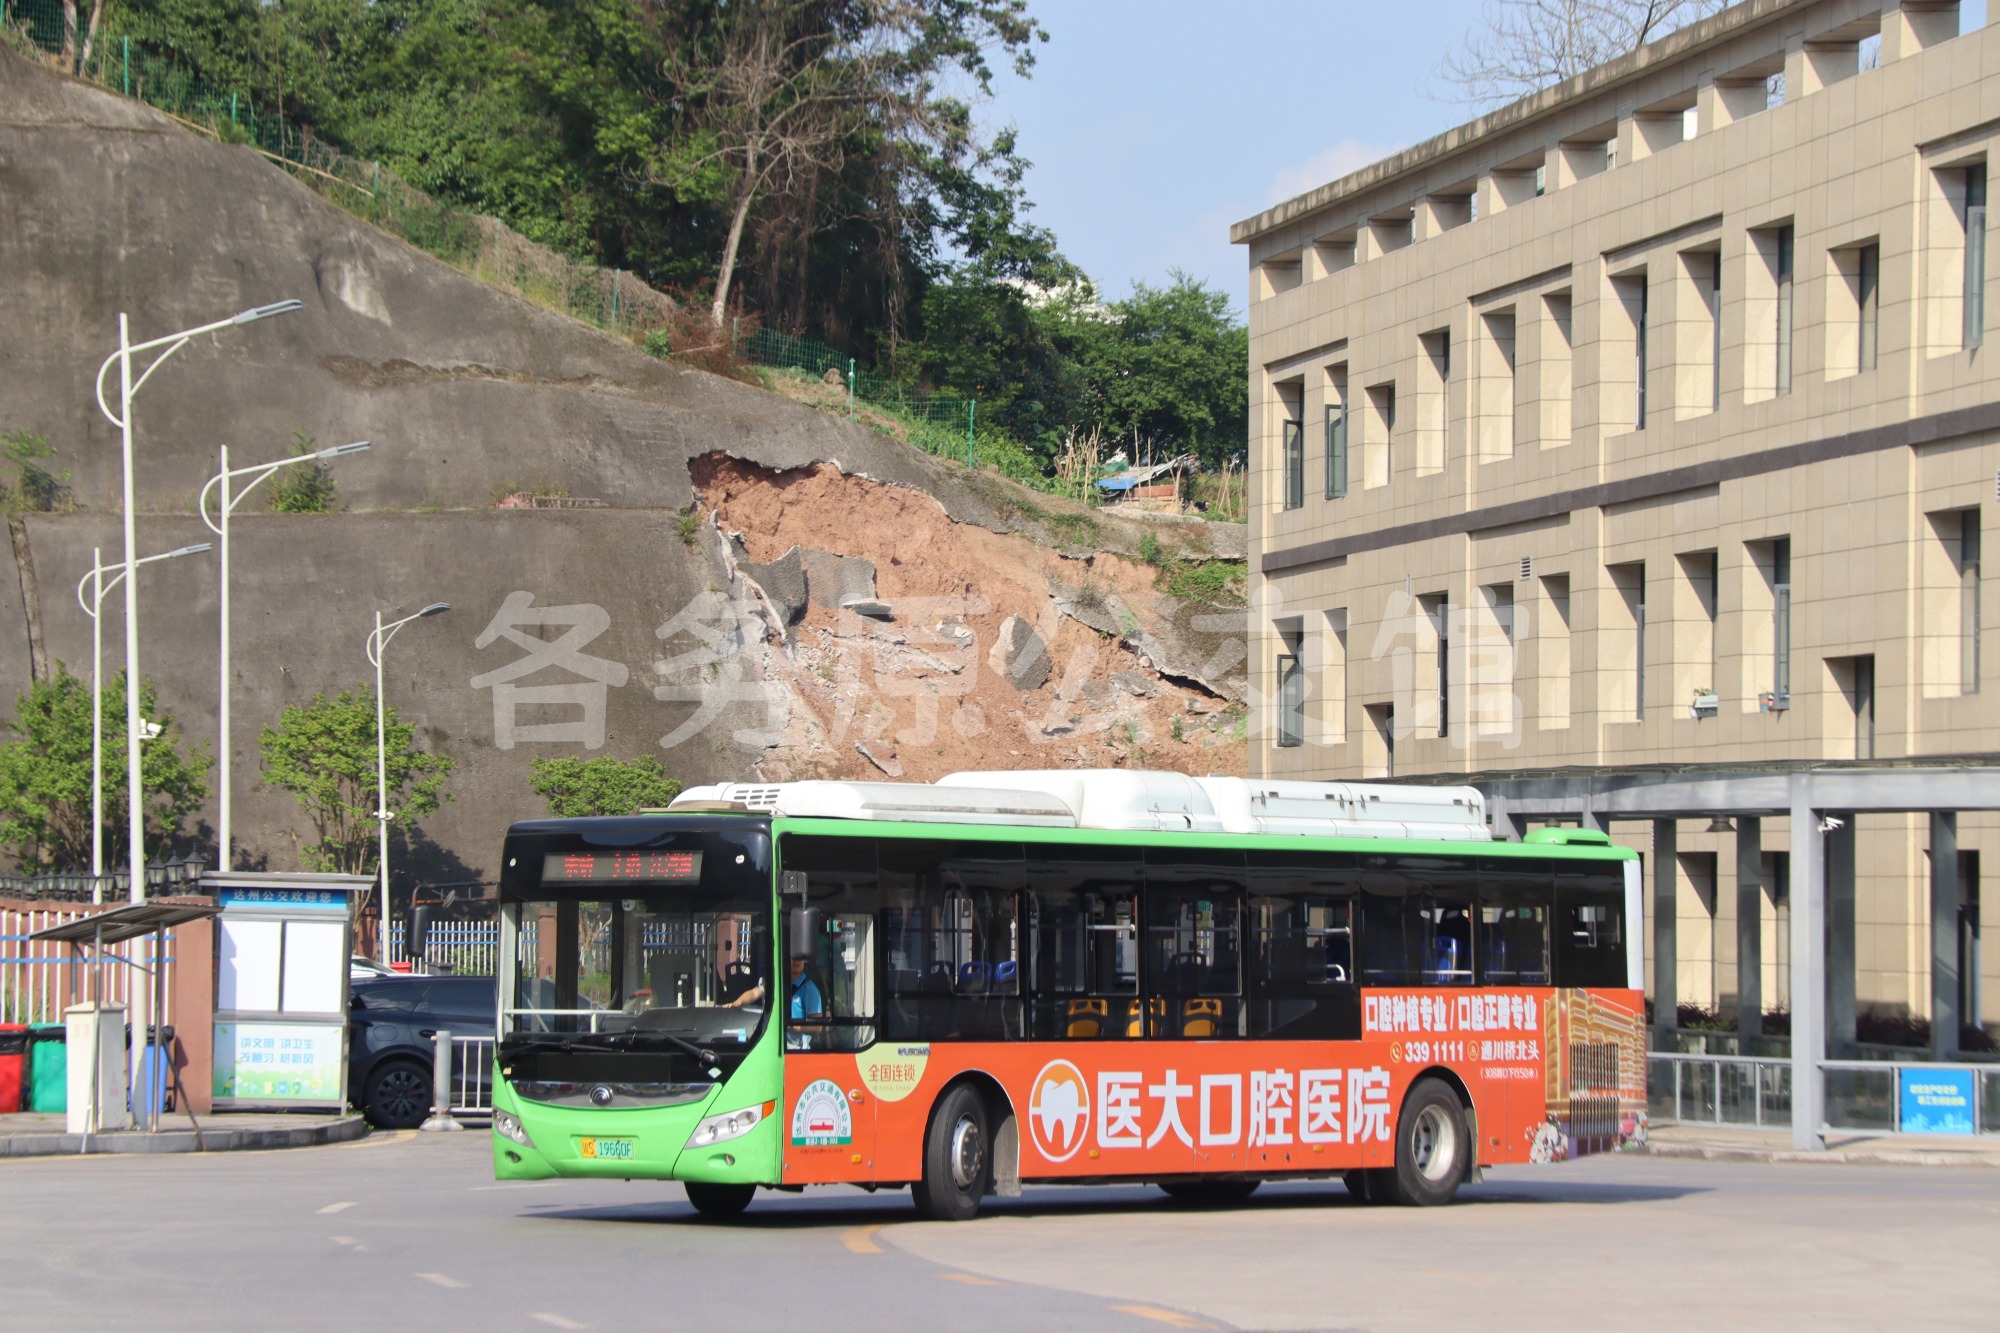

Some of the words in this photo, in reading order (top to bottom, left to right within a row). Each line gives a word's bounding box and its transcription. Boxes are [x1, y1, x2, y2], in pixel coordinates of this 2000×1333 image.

[233, 889, 332, 903] 达州公交欢迎您
[241, 1037, 275, 1049] 讲文明
[1405, 1042, 1430, 1062] 339
[1434, 1041, 1464, 1062] 1111
[1480, 1040, 1540, 1061] 通川桥北头
[868, 1063, 915, 1082] 全国连锁
[1097, 1066, 1391, 1150] 医大口腔医院
